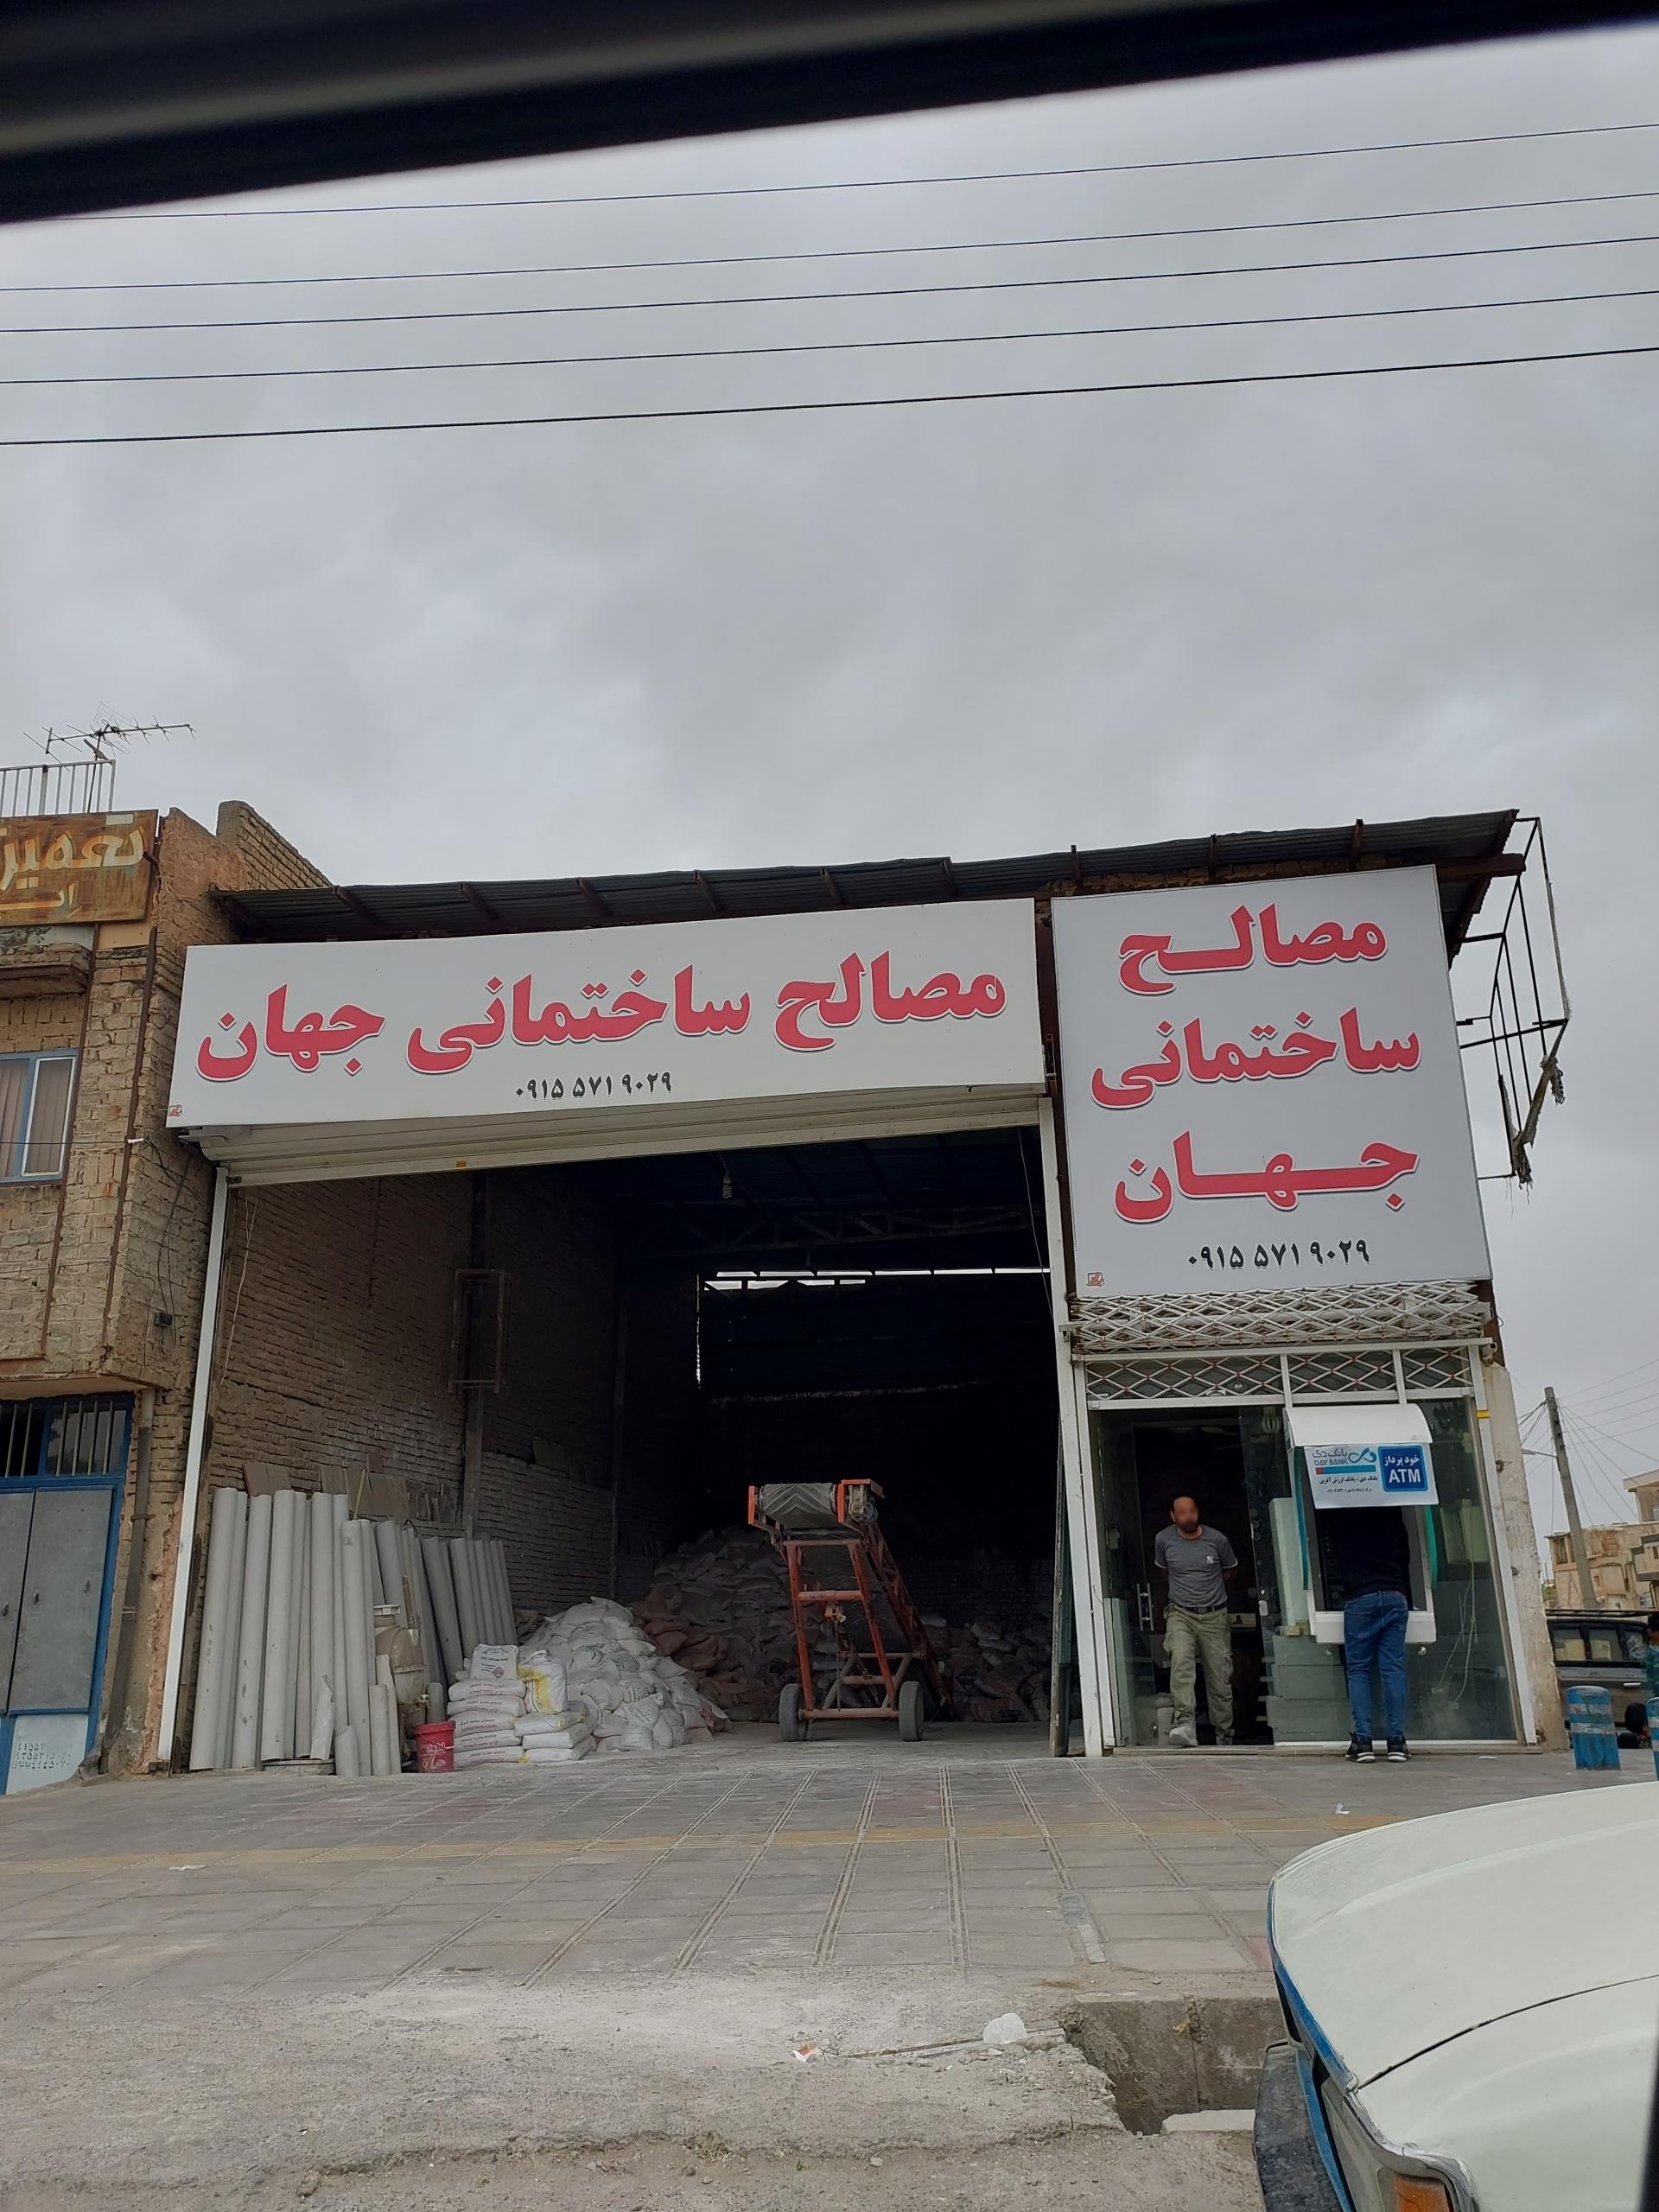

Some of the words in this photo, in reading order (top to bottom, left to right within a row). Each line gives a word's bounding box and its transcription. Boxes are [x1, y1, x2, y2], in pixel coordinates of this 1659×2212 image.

[1118, 903, 1388, 995] مصالح
[196, 984, 385, 1082] جهان
[406, 964, 752, 1074] ساختمانی
[774, 950, 1007, 1051] مصالح
[1090, 1007, 1421, 1109] ساختمانی
[1114, 1130, 1419, 1224] جهان
[1327, 1447, 1348, 1459] بانک
[1389, 1468, 1421, 1484] ATM
